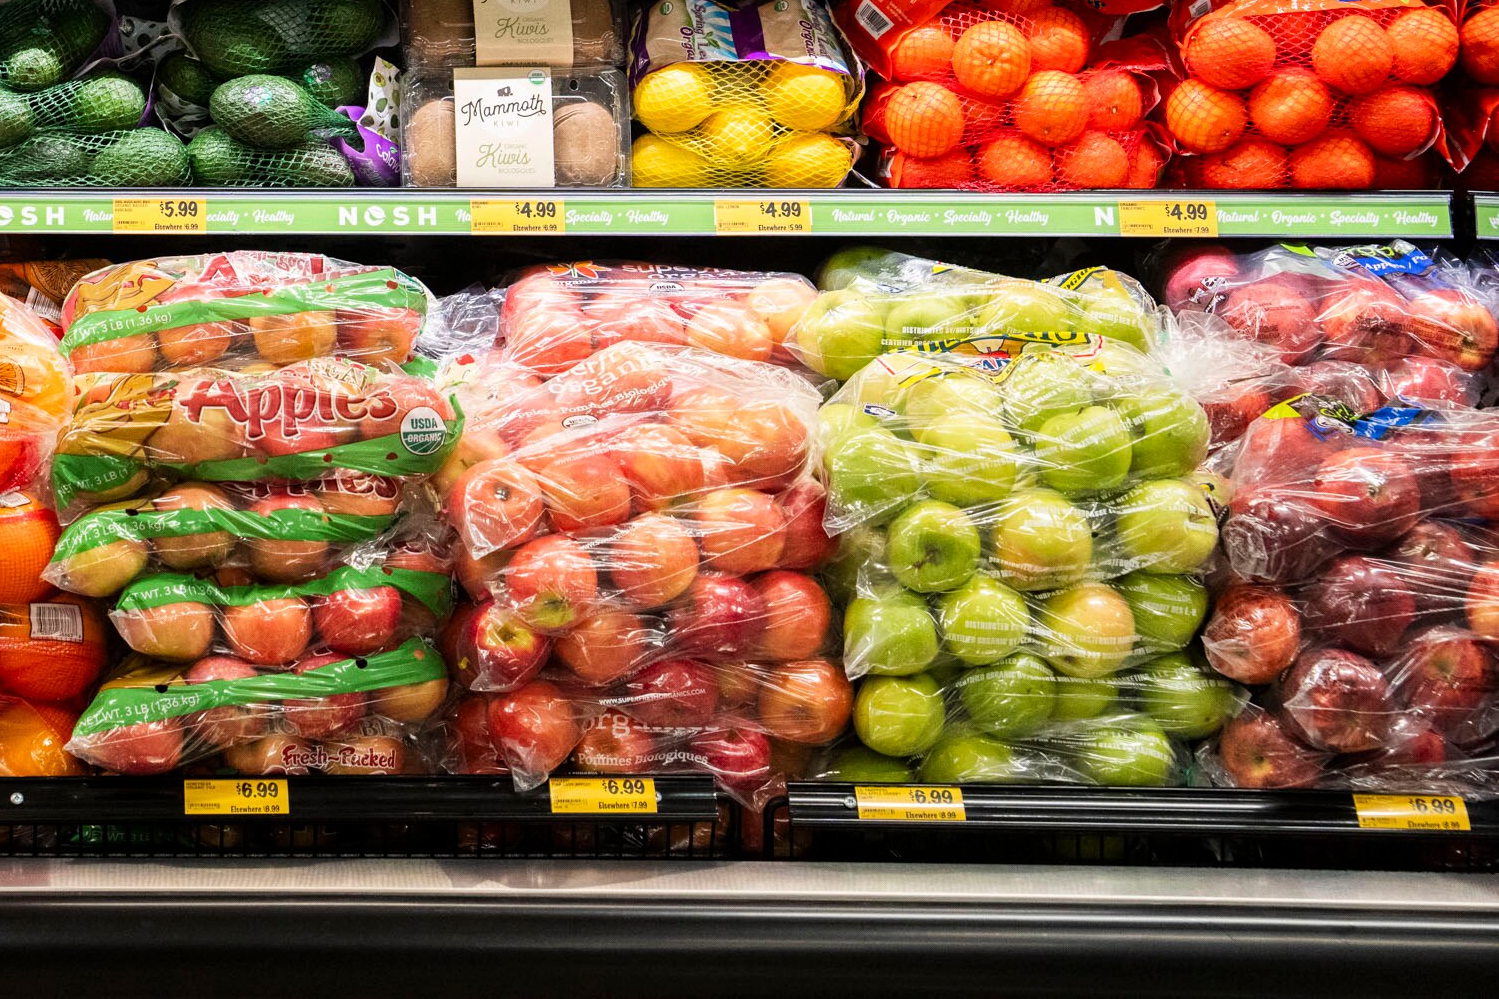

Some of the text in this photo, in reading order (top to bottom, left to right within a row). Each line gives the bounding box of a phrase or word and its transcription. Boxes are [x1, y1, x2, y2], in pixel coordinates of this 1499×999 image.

[494, 16, 550, 39] Kiwis
[460, 94, 547, 126] Mammoth
[475, 143, 531, 169] Kiwis
[159, 200, 198, 217] $5.99
[338, 206, 436, 225] NOSH
[515, 201, 556, 218] $4.99
[832, 208, 1048, 226] Natural Organic Specialty Healthy
[1165, 203, 1207, 221] $4.99
[1164, 226, 1192, 234] Elsewhere
[181, 380, 398, 441] Apples
[410, 417, 438, 430] USDA
[406, 431, 443, 444] ORGANIC
[635, 749, 709, 767] Biologiques
[236, 781, 279, 798] $6.99
[602, 778, 645, 795] $6.99
[230, 804, 262, 813] Elsewhere
